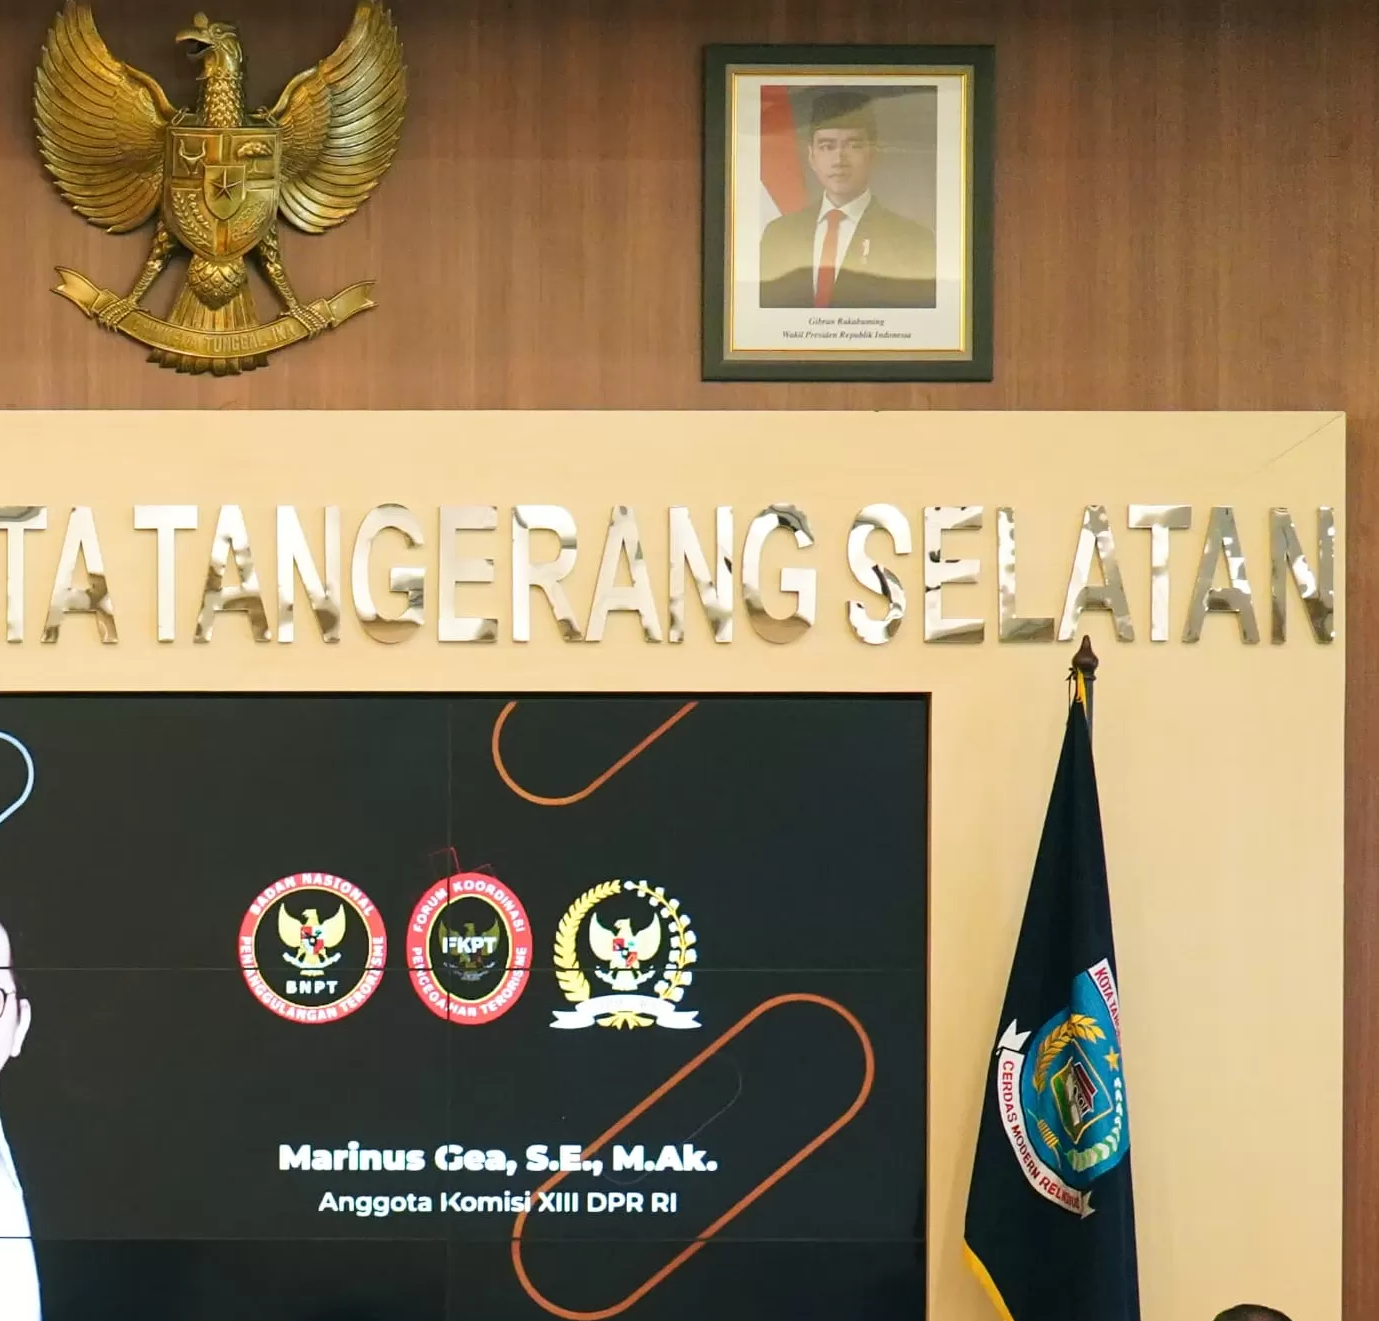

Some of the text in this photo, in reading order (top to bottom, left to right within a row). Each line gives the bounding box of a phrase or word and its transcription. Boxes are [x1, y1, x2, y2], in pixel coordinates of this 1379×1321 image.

[133, 503, 817, 644] TANGERANG
[847, 503, 1335, 644] SELATAN
[249, 873, 374, 916] BADAN NASIONAL
[413, 880, 526, 932] FORUM KOORDINASI
[443, 936, 497, 954] FKPT
[241, 936, 337, 1020] PENANGGULANGAN
[285, 980, 339, 994] BNPT
[1095, 967, 1113, 1001] KOTA
[1002, 1060, 1041, 1180] CERDAS MODERN
[279, 1141, 718, 1176] Marinus Gea, S.E., M.Ak.
[318, 1190, 677, 1217] Anggota Komisi XIII DPR RI
